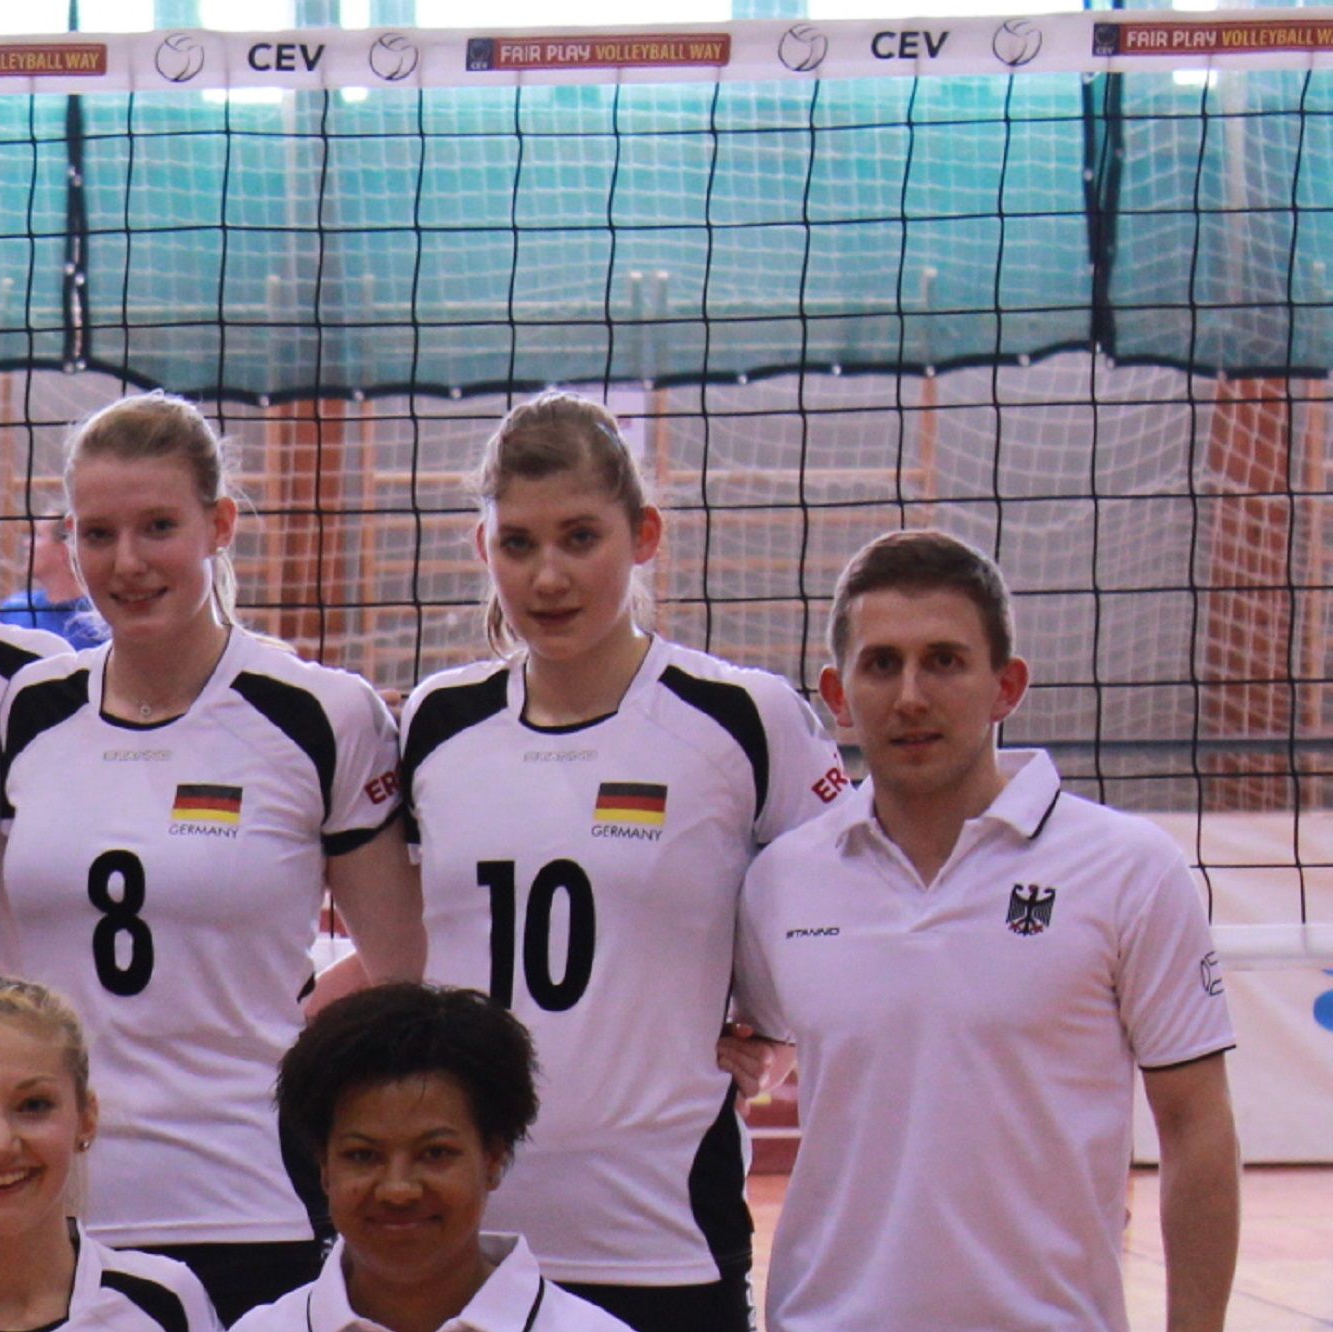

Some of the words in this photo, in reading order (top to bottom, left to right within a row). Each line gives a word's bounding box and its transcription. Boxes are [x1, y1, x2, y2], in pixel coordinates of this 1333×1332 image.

[871, 30, 949, 59] CEV
[1126, 31, 1168, 48] FAIR
[1172, 30, 1217, 47] PLAY
[1221, 29, 1313, 46] VOLLEYBALL
[1317, 28, 1333, 45] W
[64, 52, 99, 69] WAY
[248, 42, 325, 72] CEV
[500, 45, 541, 61] FAIR
[546, 44, 590, 61] PLAY
[595, 43, 686, 60] VOLLEYBALL
[689, 42, 723, 59] WAY
[811, 766, 850, 805] ER
[168, 823, 239, 838] GERMANY
[591, 825, 663, 842] GERMANY
[88, 849, 154, 996] 8
[477, 858, 596, 1012] 10
